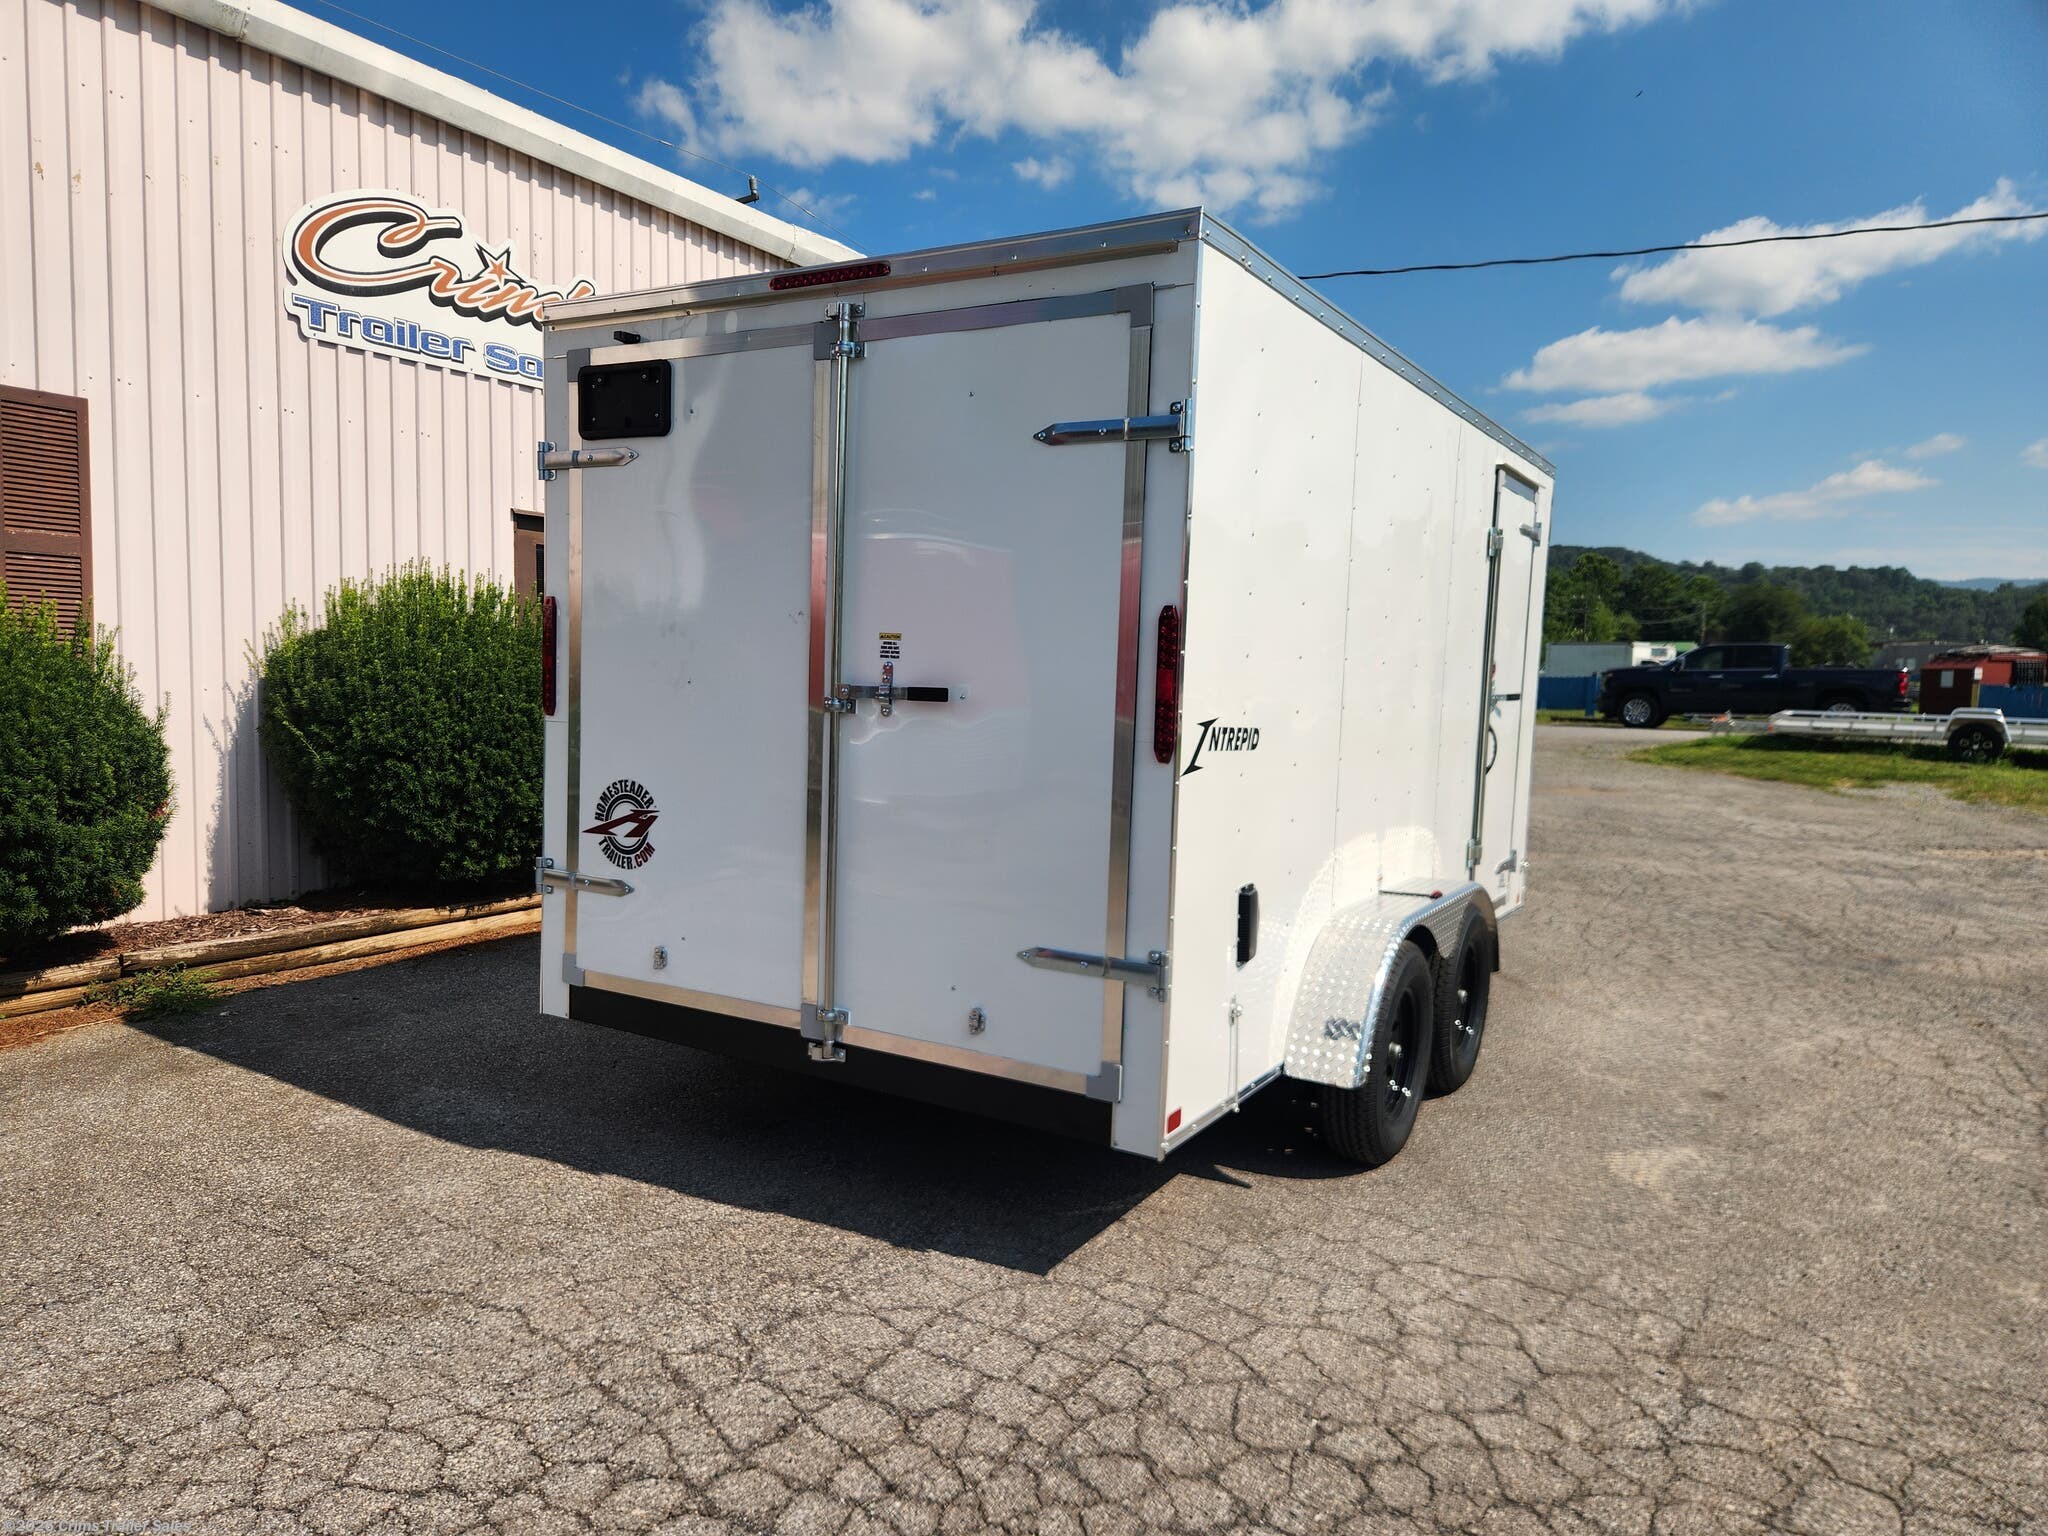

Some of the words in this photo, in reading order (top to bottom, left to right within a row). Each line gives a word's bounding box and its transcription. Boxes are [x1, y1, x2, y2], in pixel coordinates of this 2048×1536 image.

[292, 293, 476, 363] Trailer
[1180, 717, 1260, 777] INTREPID
[595, 779, 654, 821] HOMESTEADER
[598, 836, 656, 870] TRAILER.COM
